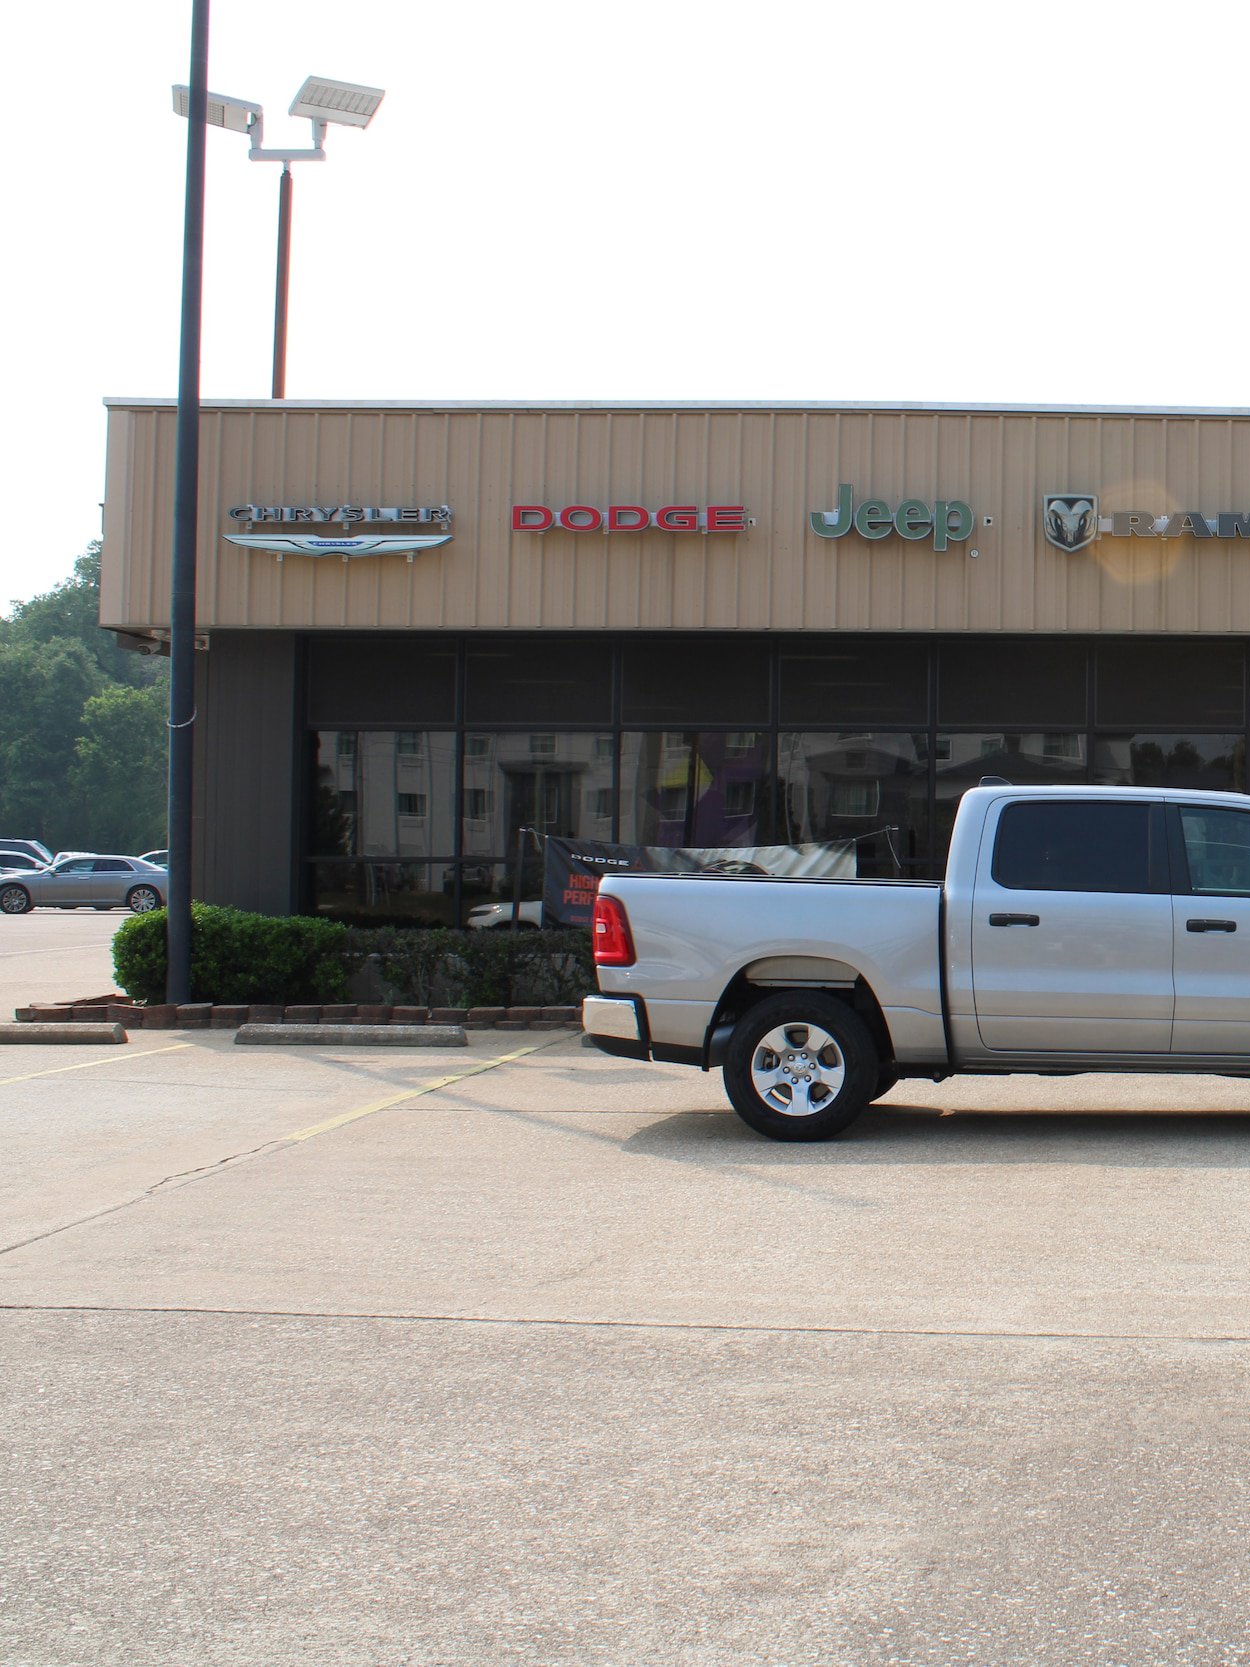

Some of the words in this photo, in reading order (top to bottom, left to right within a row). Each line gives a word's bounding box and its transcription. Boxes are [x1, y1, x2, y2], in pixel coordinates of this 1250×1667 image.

[229, 504, 453, 523] CHRYSLER
[511, 504, 747, 532] DODGE
[810, 483, 974, 552] Jeep
[571, 854, 629, 865] DODGE
